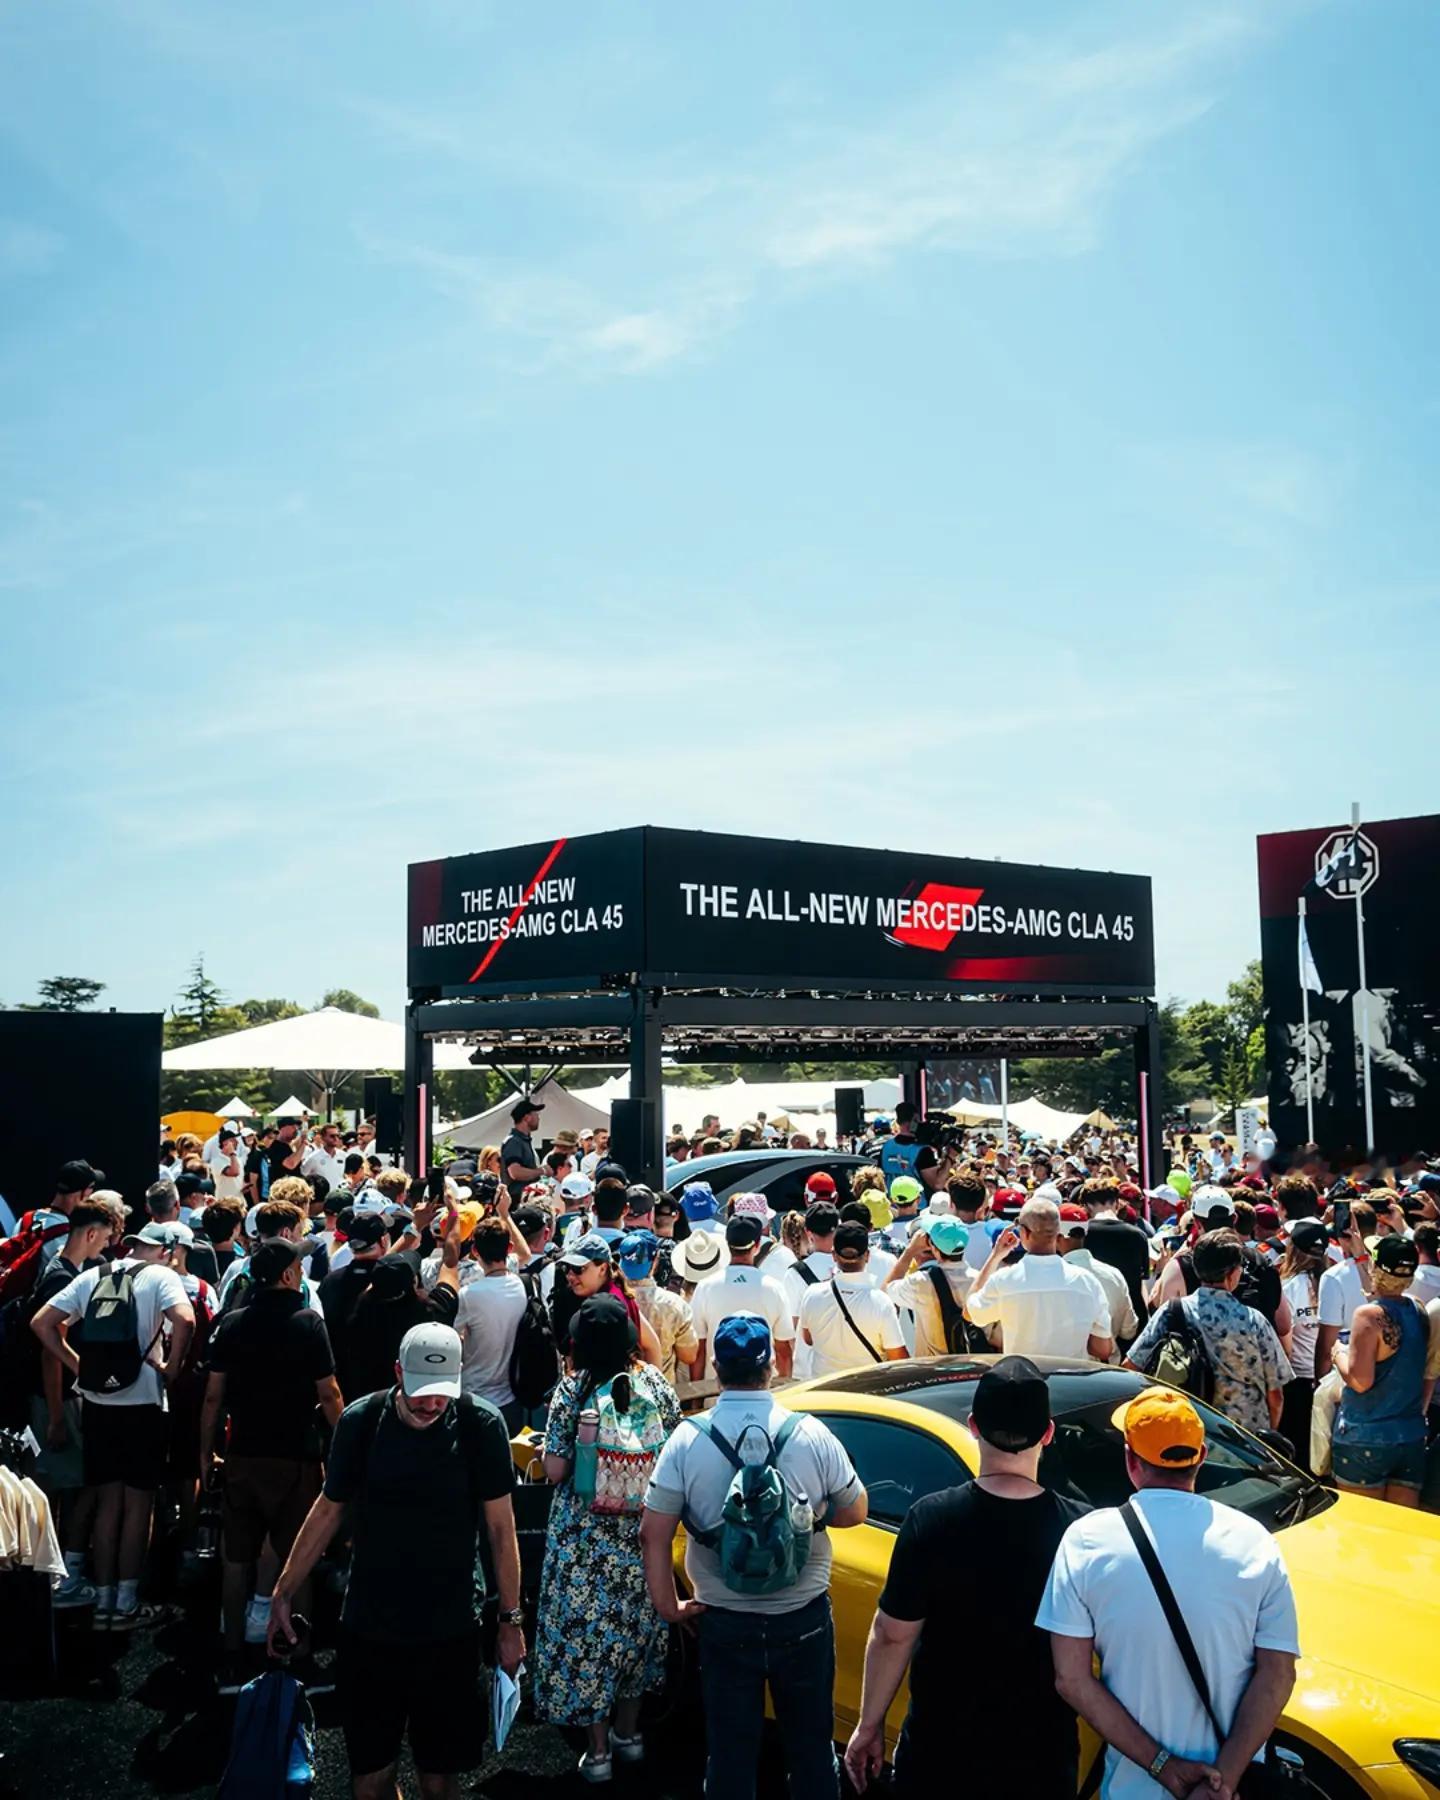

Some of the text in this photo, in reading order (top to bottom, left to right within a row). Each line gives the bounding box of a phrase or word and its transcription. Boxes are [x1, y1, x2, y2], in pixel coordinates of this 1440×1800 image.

[461, 877, 576, 914] THE ALL-NEW
[680, 883, 1134, 941] THE ALL-NEW MERCEDES-AMG CLA 45
[423, 904, 624, 947] MERCEDES-AMG CLA 45
